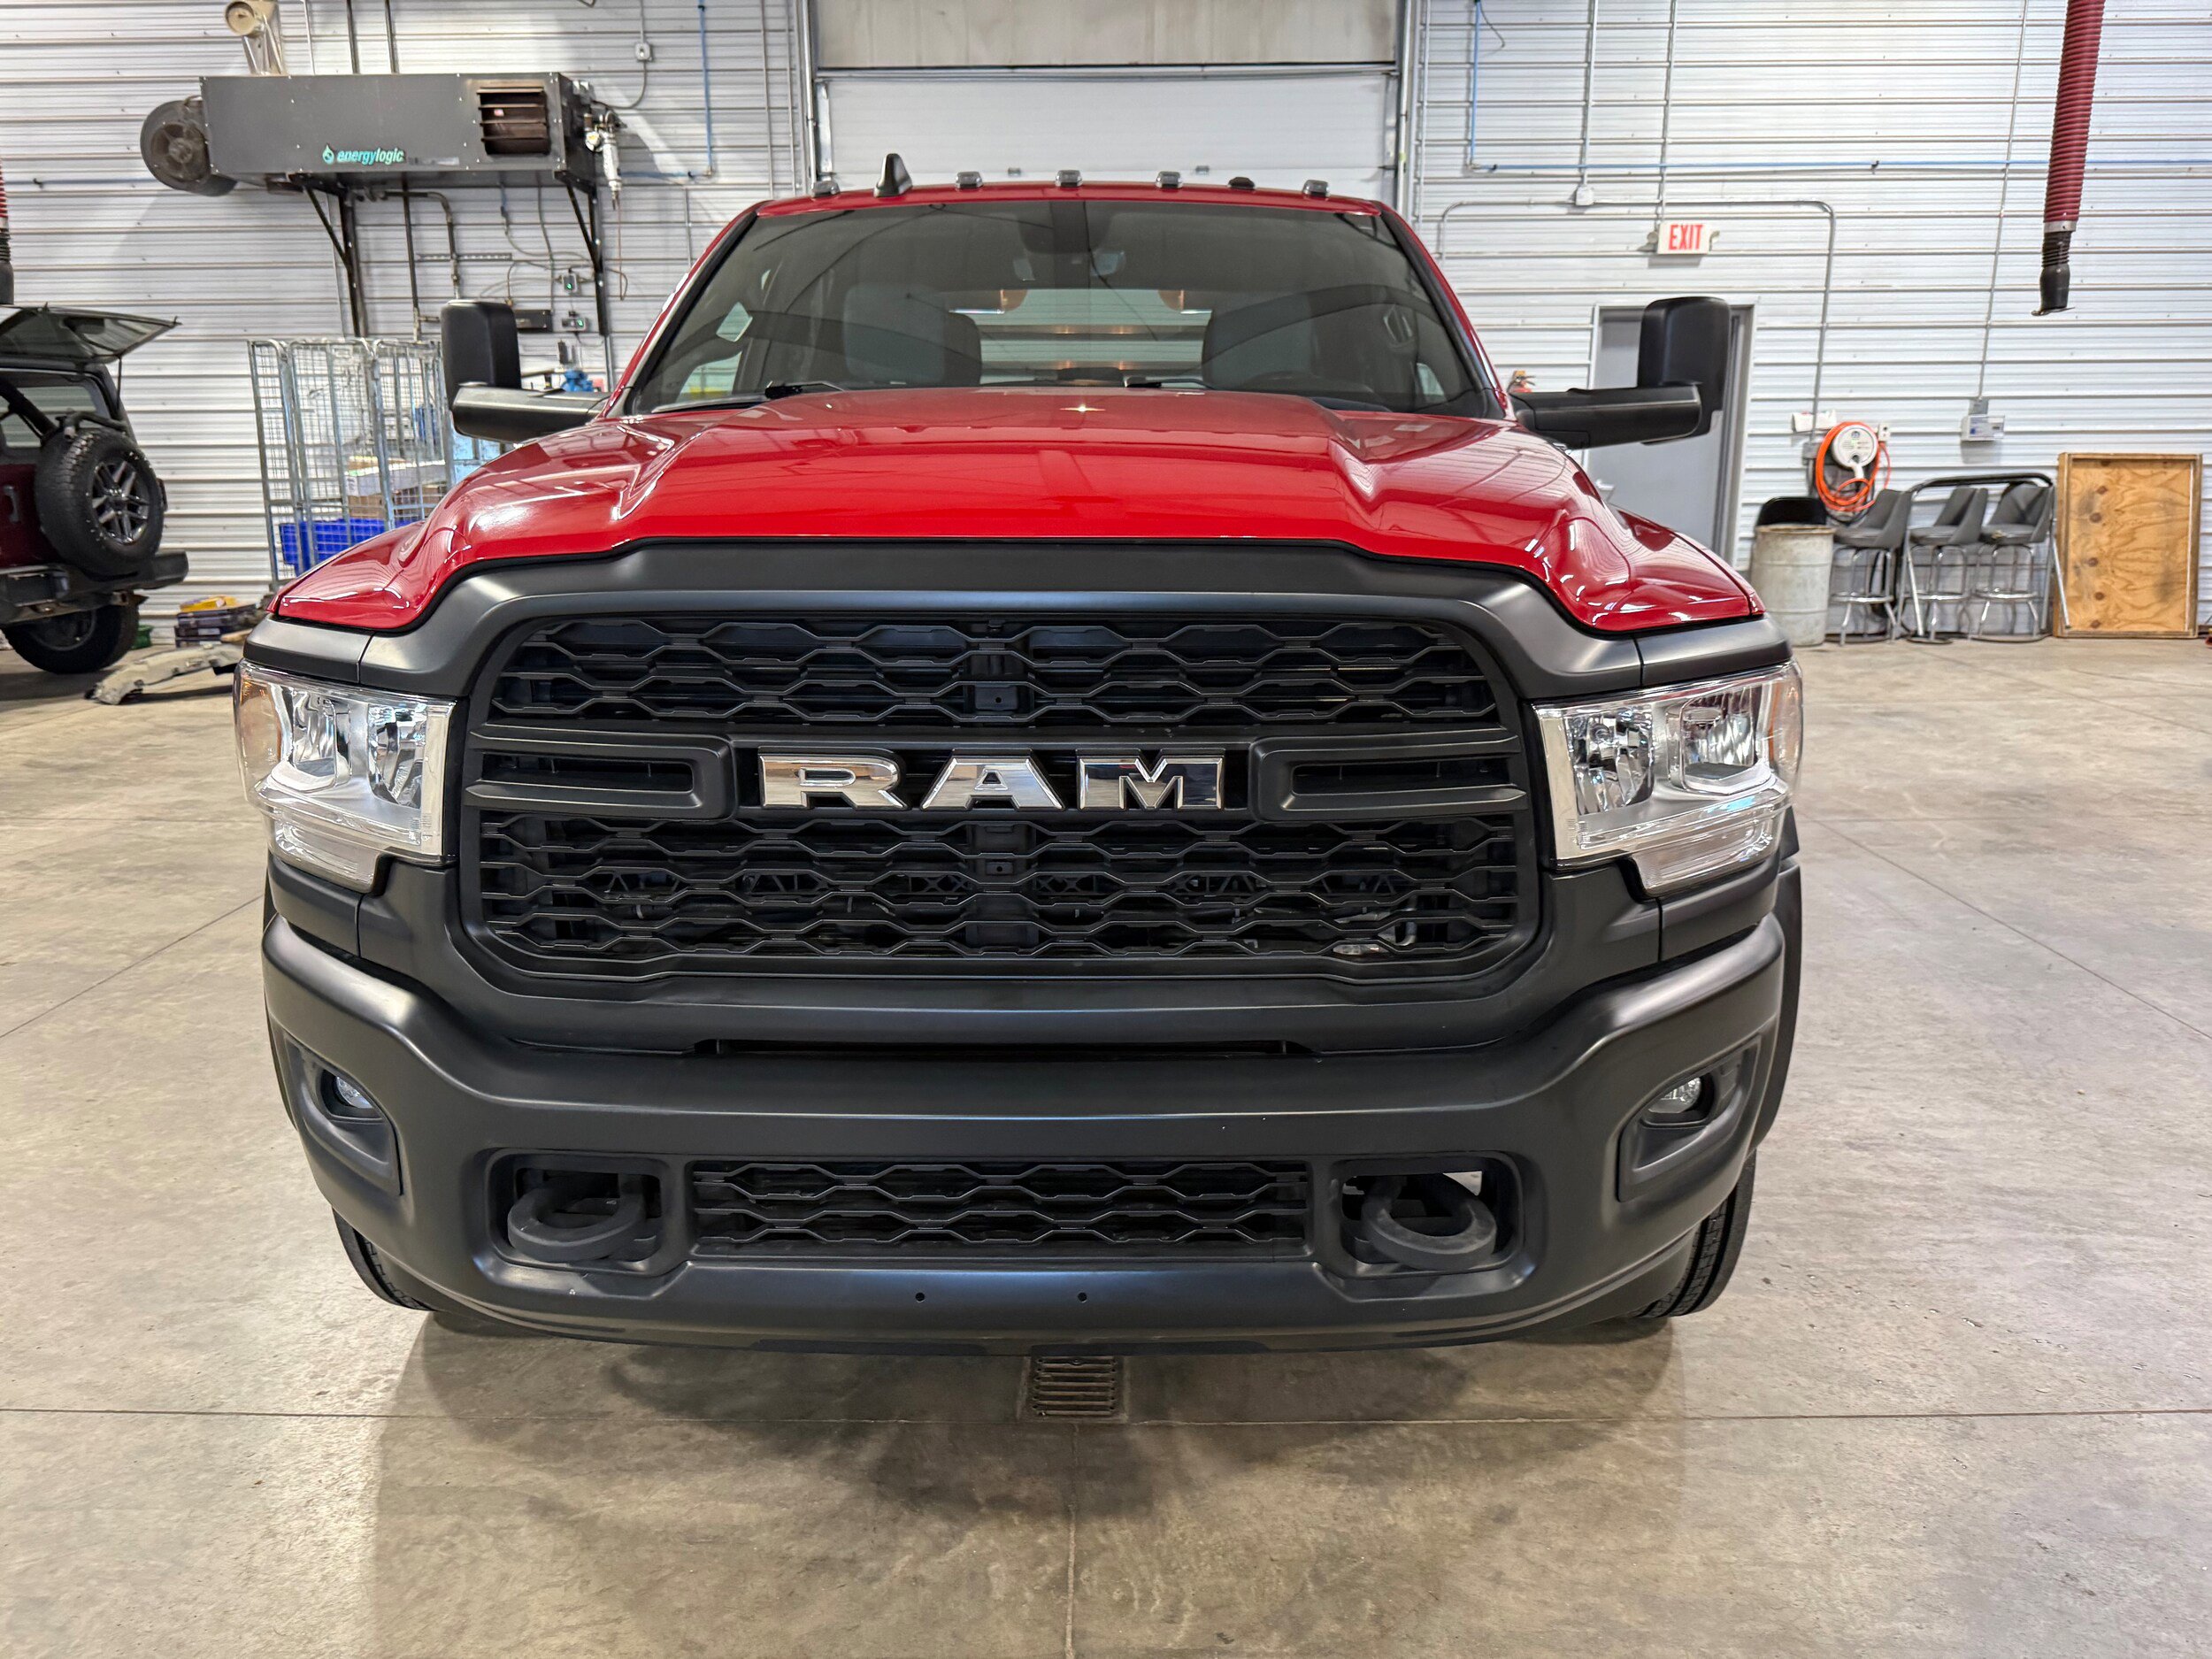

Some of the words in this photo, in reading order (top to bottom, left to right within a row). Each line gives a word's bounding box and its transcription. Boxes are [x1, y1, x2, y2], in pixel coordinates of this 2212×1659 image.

[337, 148, 405, 165] energylogic
[1669, 225, 1703, 250] EXIT
[759, 750, 1225, 810] RAM
